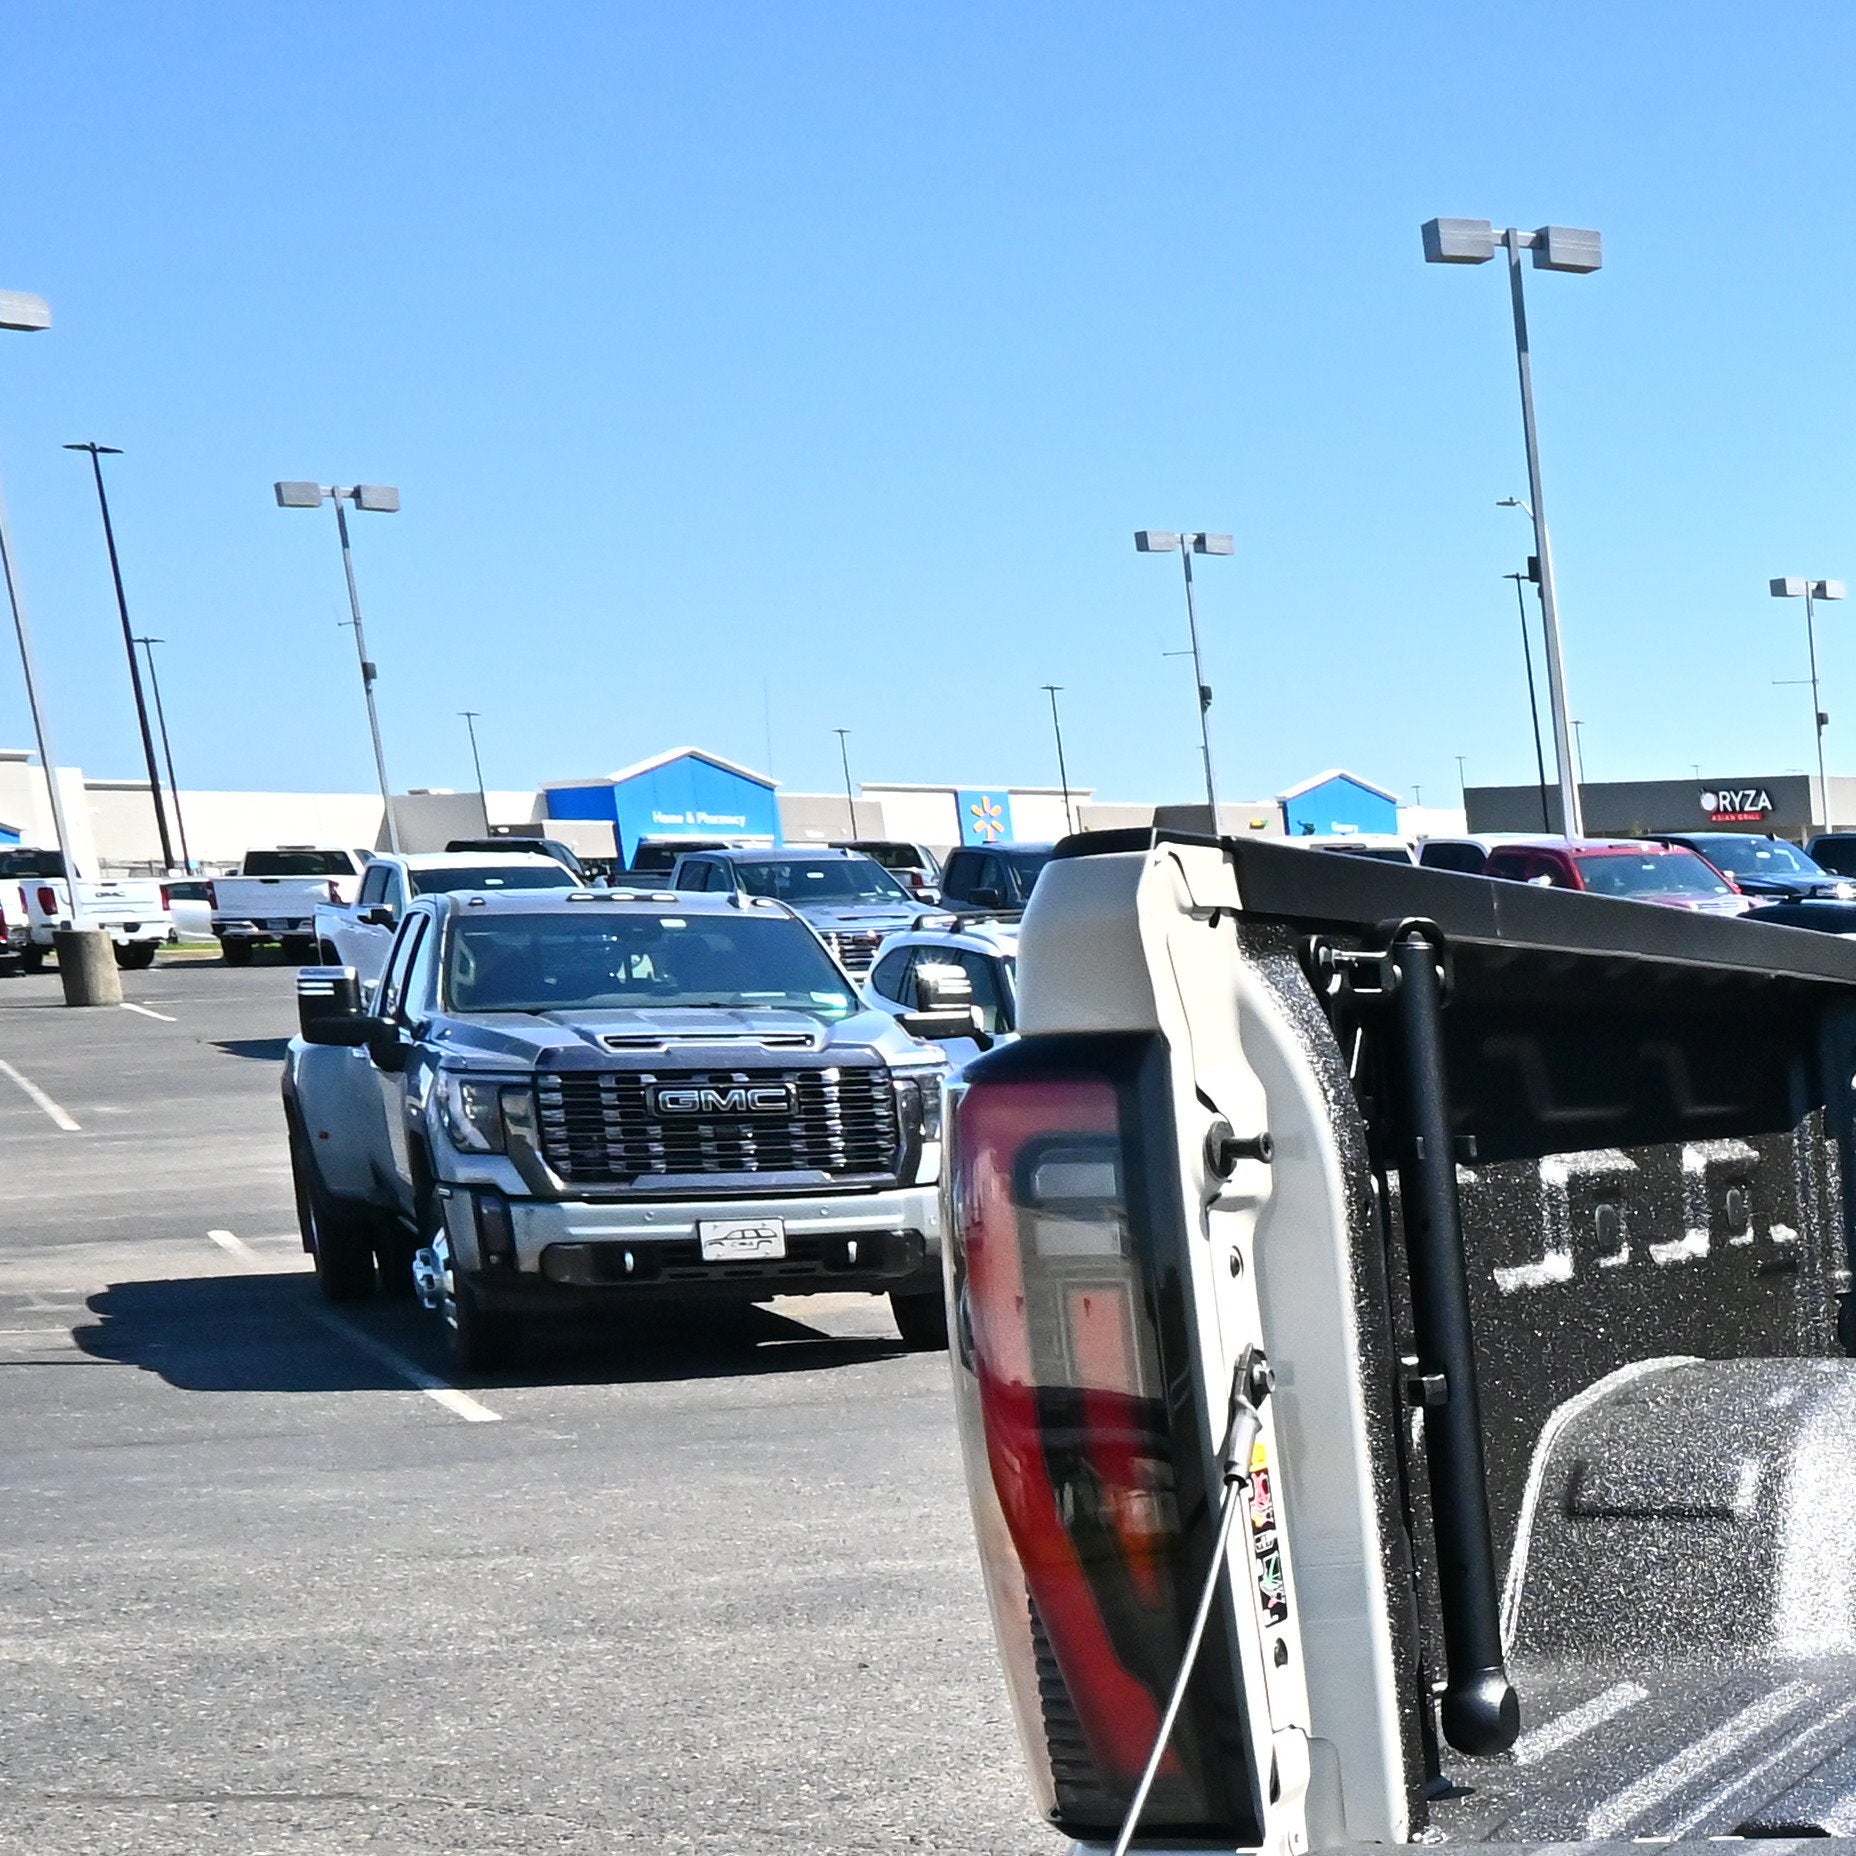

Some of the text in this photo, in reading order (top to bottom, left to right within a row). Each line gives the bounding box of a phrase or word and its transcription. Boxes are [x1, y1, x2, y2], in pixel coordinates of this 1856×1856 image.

[652, 811, 684, 824] Home
[696, 811, 746, 828] Pharmacy
[658, 1088, 788, 1112] GMC
